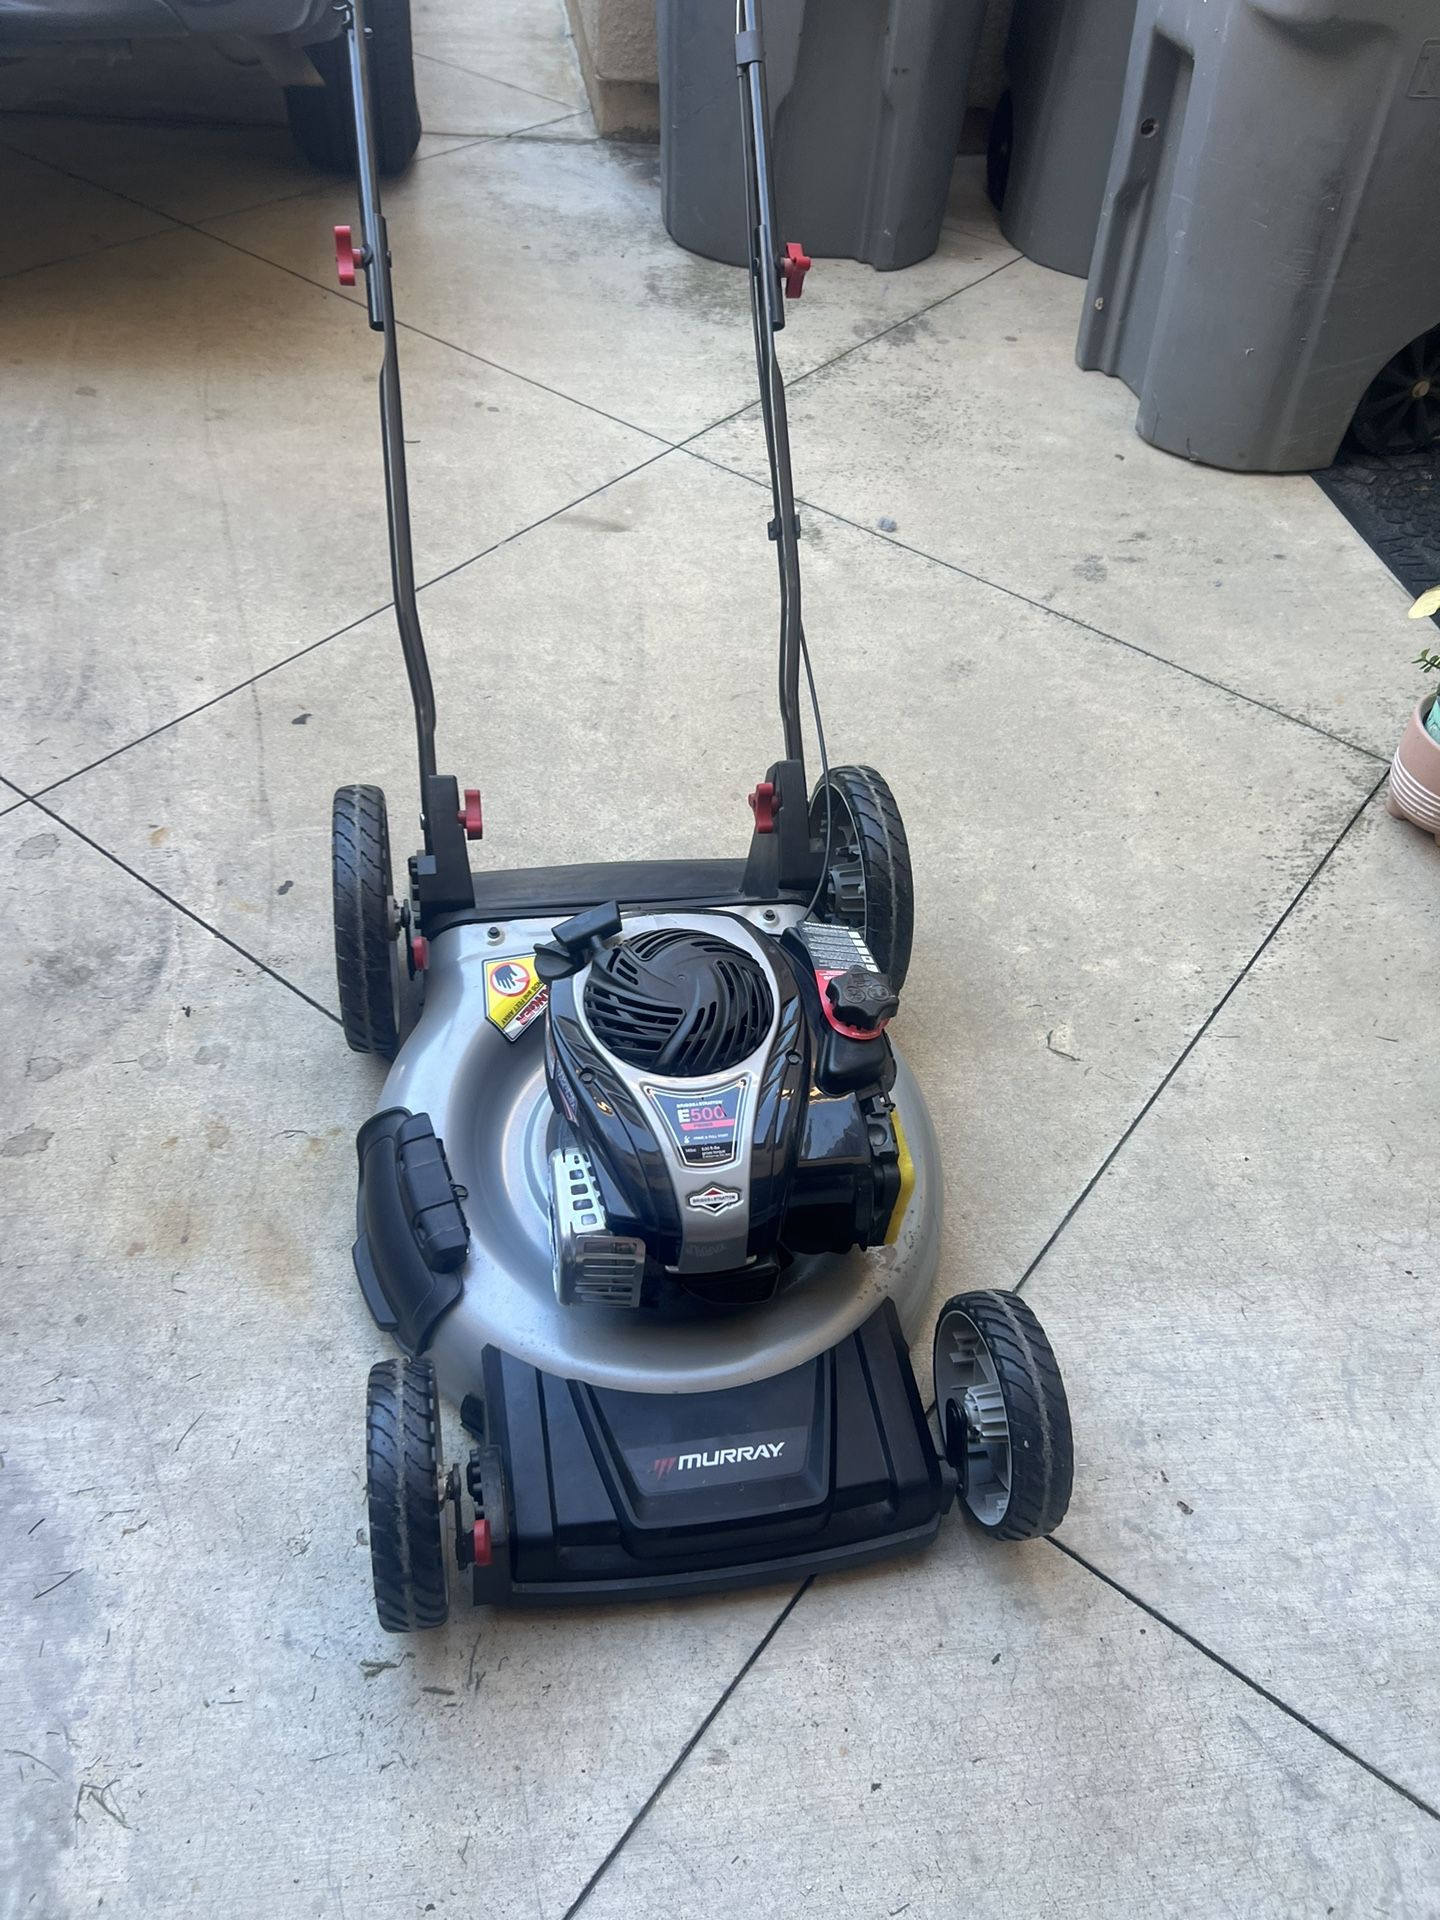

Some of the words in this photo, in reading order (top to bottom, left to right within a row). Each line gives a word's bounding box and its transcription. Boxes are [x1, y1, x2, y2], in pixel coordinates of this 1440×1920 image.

[513, 999, 525, 1011] FEET
[516, 988, 549, 1025] ANGER
[501, 1010, 514, 1024] AWAY
[677, 1105, 725, 1123] E500
[678, 1441, 785, 1471] MURRAY
